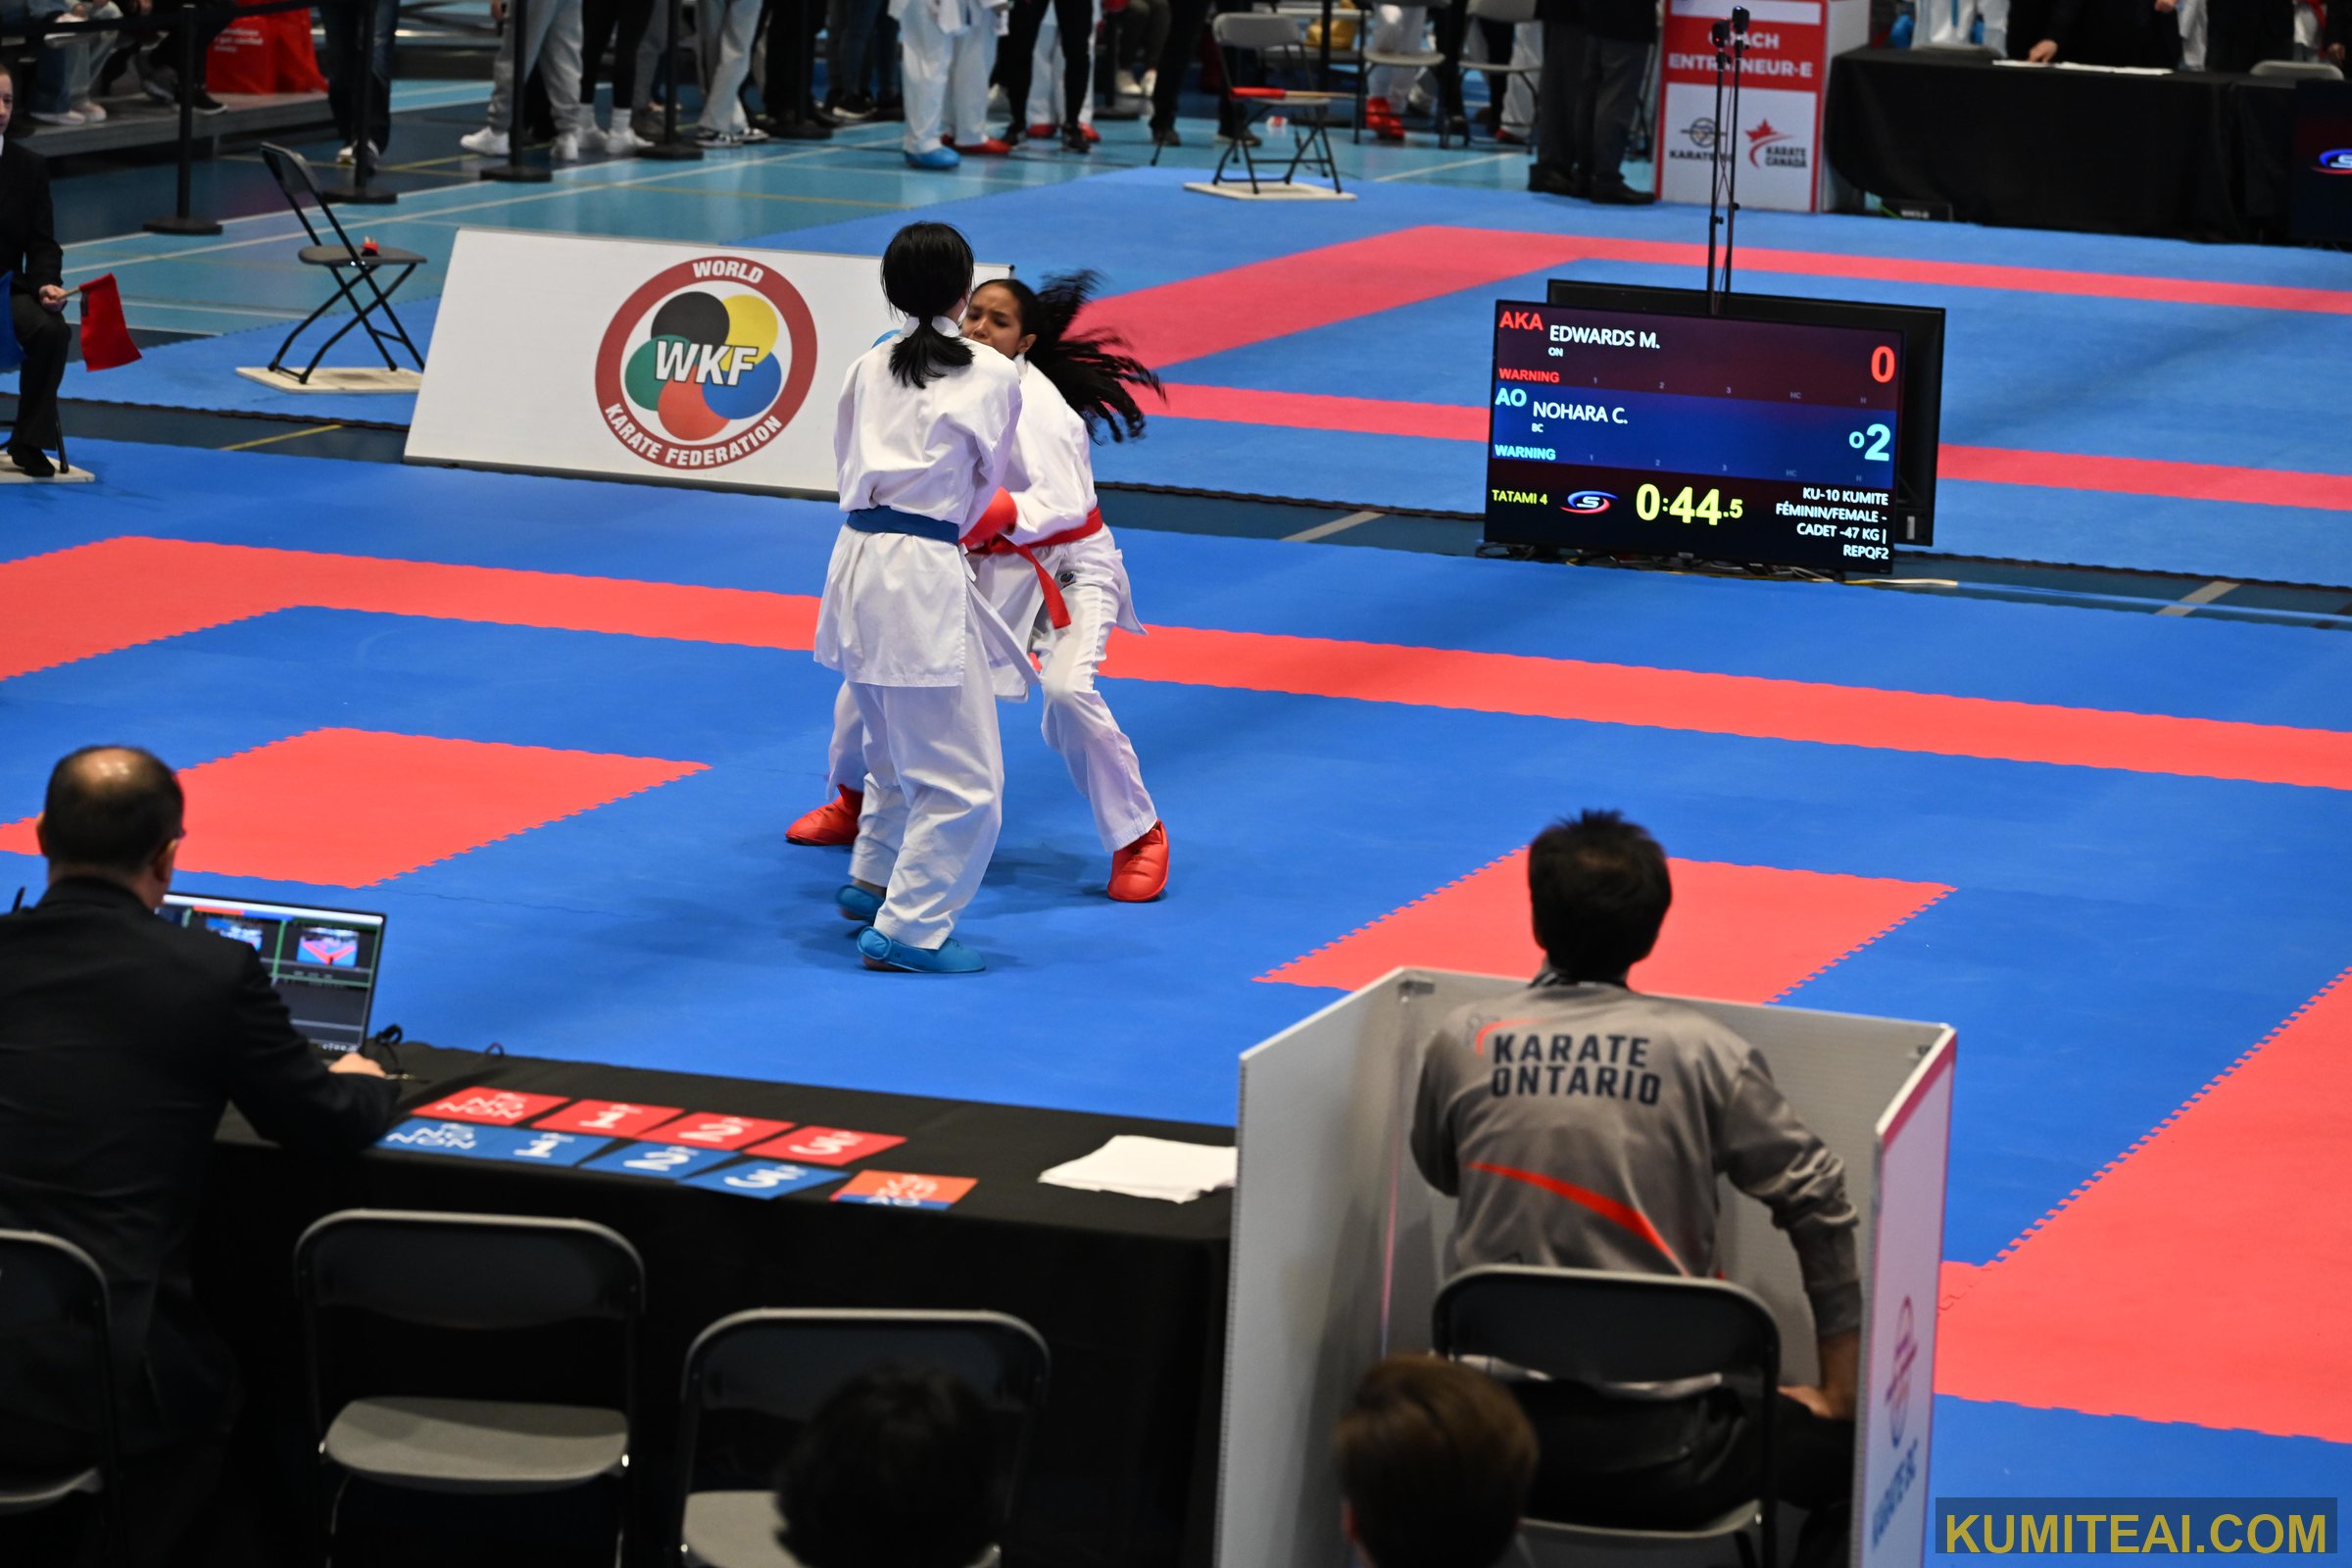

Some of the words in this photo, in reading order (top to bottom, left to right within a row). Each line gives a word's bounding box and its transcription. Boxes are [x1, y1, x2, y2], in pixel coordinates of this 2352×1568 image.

[693, 260, 764, 284] WORLD
[1498, 310, 1544, 331] AKA
[1549, 324, 1635, 347] EDWARDS
[1640, 330, 1661, 349] M.
[1547, 347, 1563, 358] ON
[655, 339, 760, 387] WKF
[1870, 345, 1896, 383] 0
[1498, 368, 1560, 383] WARNING
[1494, 387, 1527, 407] AO
[1533, 401, 1608, 422] NOHARA
[1612, 408, 1628, 424] C.
[604, 403, 662, 460] KARATE
[664, 415, 784, 466] FEDERATION
[1531, 422, 1544, 433] BC
[1494, 444, 1556, 461] WARNING
[1492, 489, 1538, 505] TATAMI
[1540, 493, 1548, 506] 4
[1802, 487, 1840, 502] KU-10
[1842, 491, 1889, 506] KUMITE
[1776, 500, 1879, 522] FÉMININ/FEMALE
[1796, 522, 1838, 538] CADET
[1839, 526, 1860, 539] -47
[1862, 528, 1880, 541] KG
[1842, 545, 1889, 560] REPQF2
[1494, 1034, 1650, 1068] KARATE
[1491, 1064, 1662, 1106] ONTARIO
[578, 1111, 625, 1129] 1
[677, 1123, 743, 1143] 2
[514, 1140, 559, 1158] 1
[788, 1136, 858, 1155] 3
[623, 1152, 691, 1172] 2
[723, 1168, 799, 1189] 3
